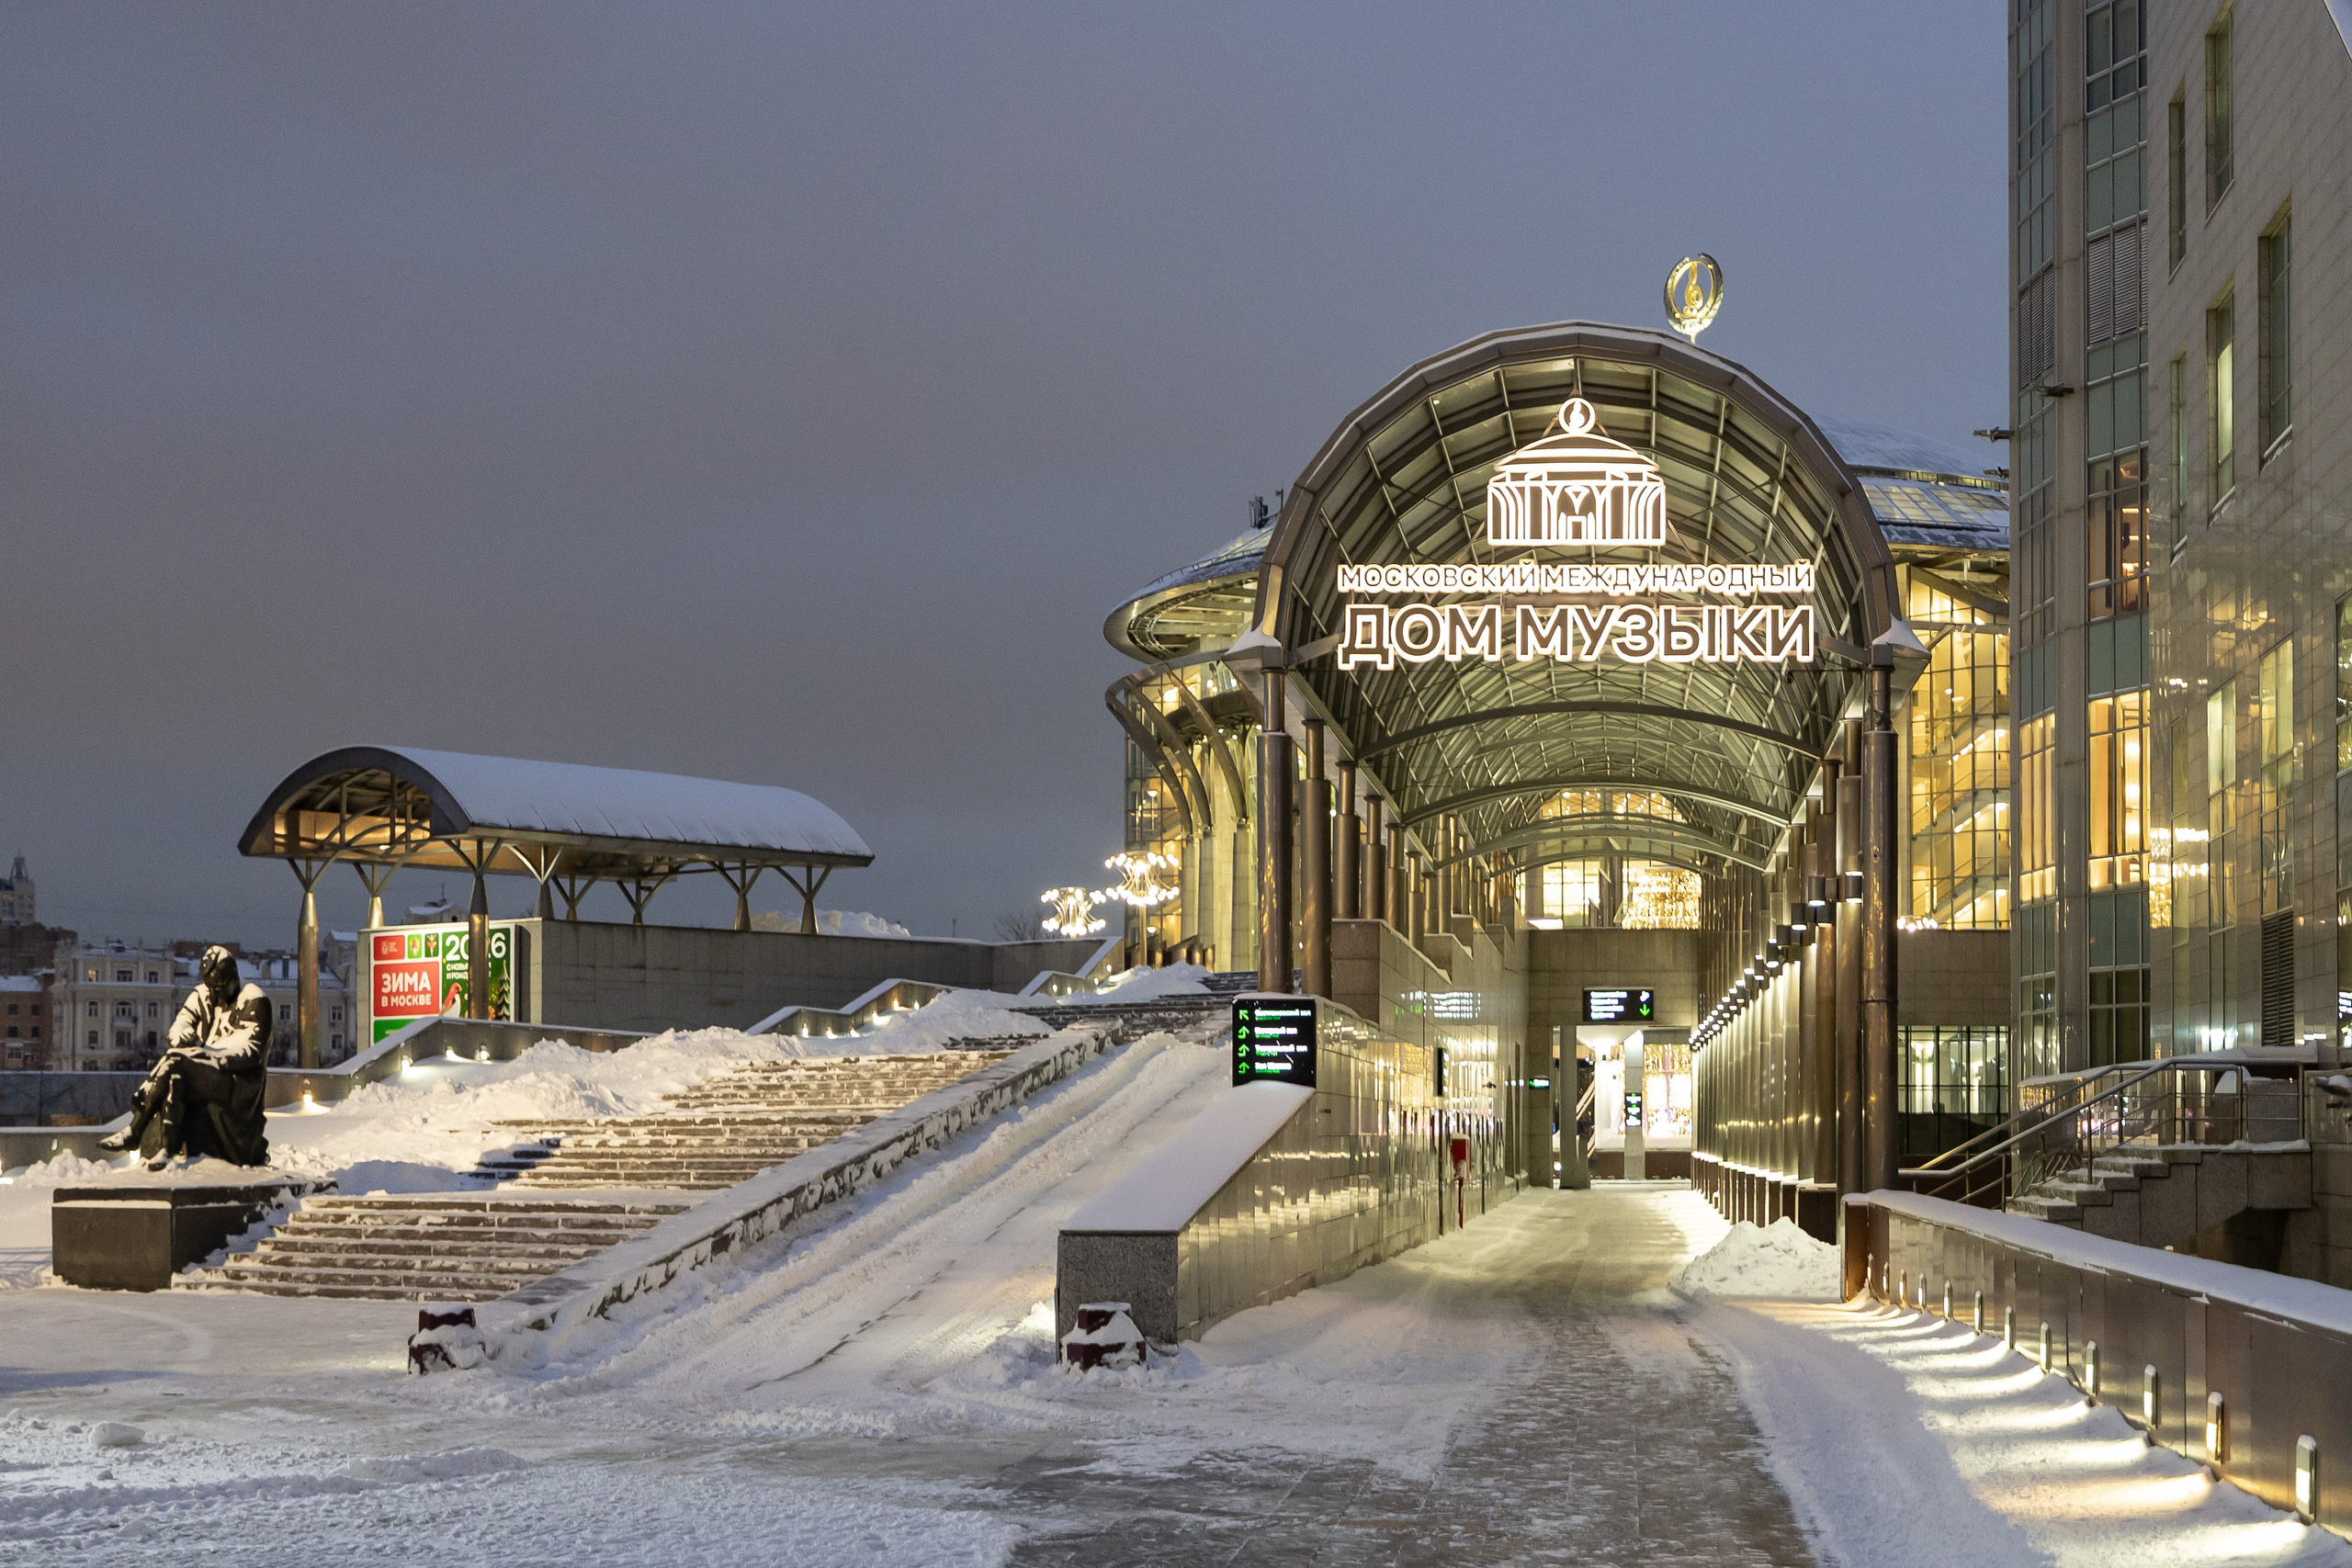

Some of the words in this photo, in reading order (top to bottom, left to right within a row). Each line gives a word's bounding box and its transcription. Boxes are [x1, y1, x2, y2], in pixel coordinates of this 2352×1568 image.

[1338, 558, 1540, 593] МОСКОВСКИЙ
[1541, 558, 1815, 596] МЕЖДУНАРОДНЫЙ
[1338, 604, 1502, 671] ДОМ
[1516, 604, 1815, 663] МУЗЫКИ
[446, 932, 506, 961] 206
[381, 971, 431, 993] ЗИМА
[381, 996, 388, 1007] В
[390, 994, 432, 1007] МОСКВЕ
